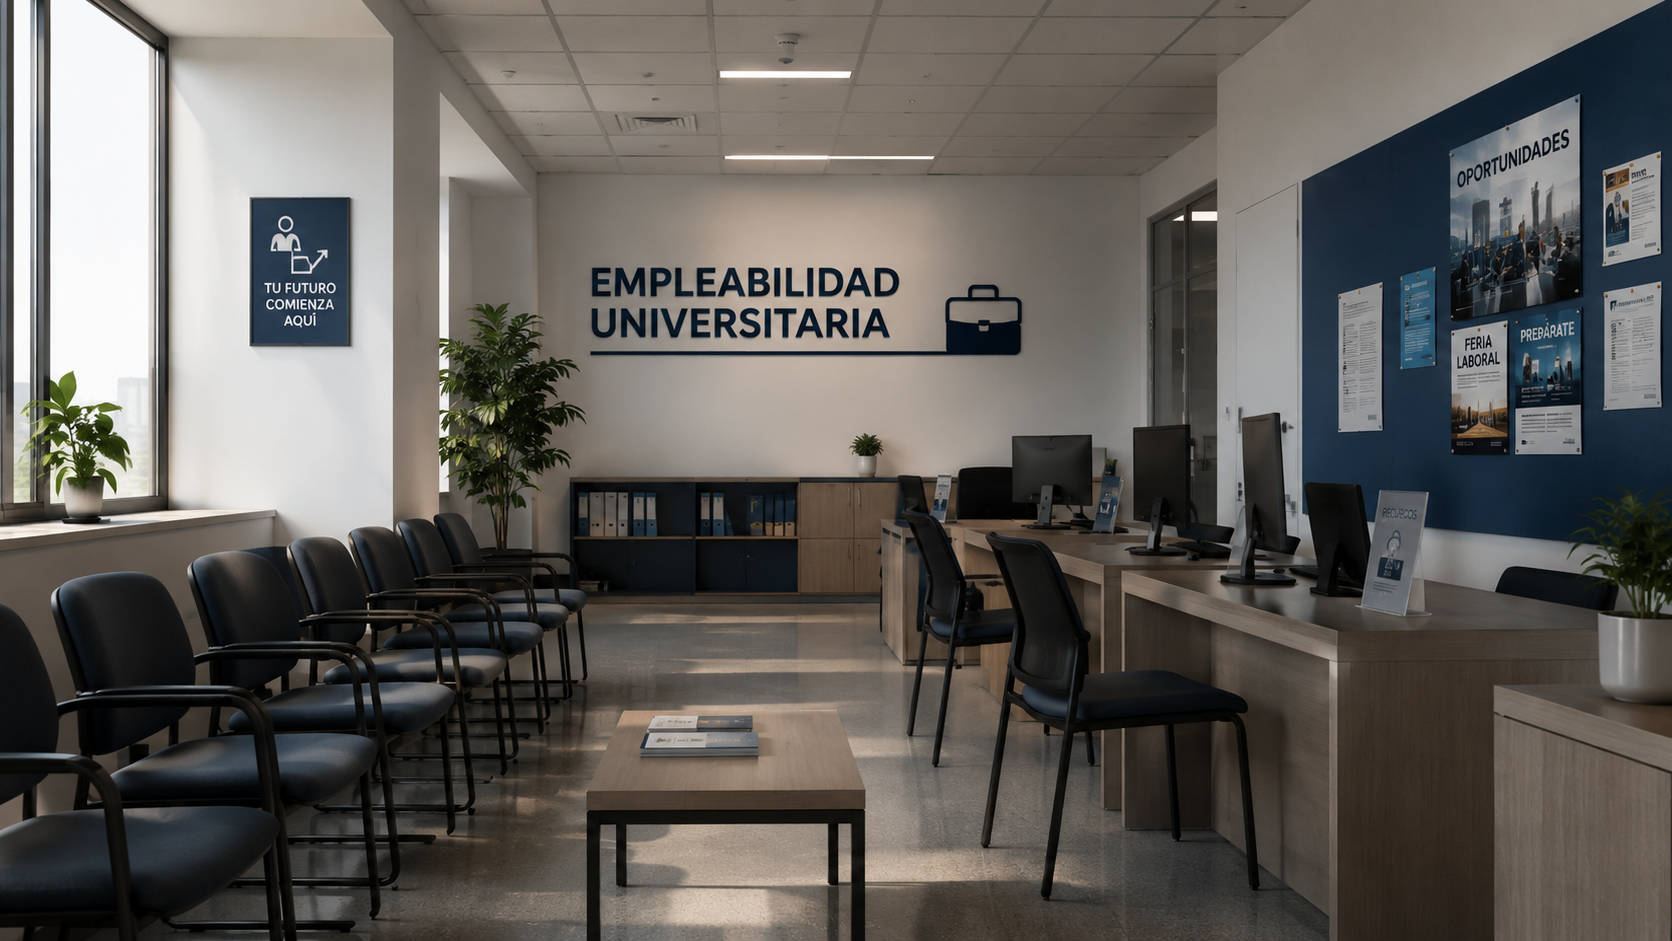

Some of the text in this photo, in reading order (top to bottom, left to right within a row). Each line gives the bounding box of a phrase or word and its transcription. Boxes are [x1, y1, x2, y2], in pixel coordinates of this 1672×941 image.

[1457, 129, 1570, 188] OPORTUNIDADES
[264, 282, 337, 294] TU FUTURO
[591, 267, 900, 298] EMPLEABILIDAD
[265, 298, 335, 310] COMIENZA
[284, 312, 317, 328] AQUÍ
[591, 308, 891, 339] UNIVERSITARIA
[1464, 334, 1492, 351] FERIA
[1457, 351, 1501, 370] LABORAL
